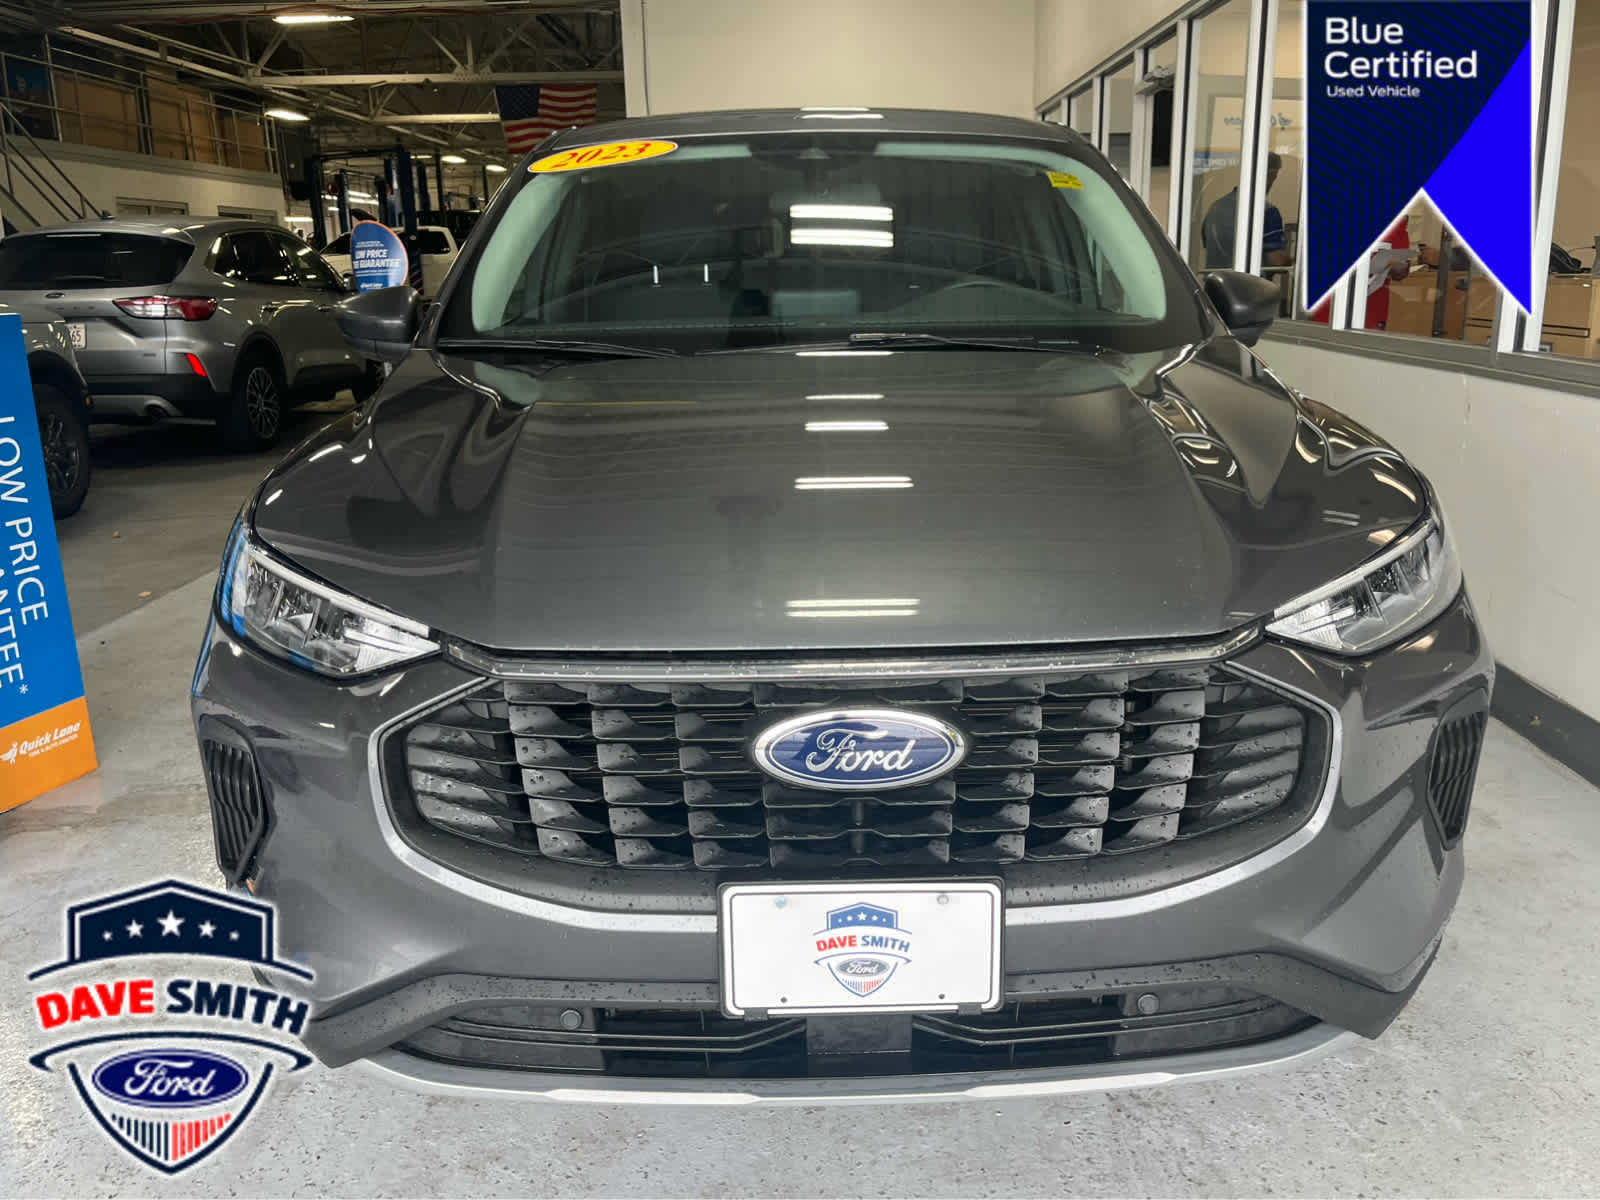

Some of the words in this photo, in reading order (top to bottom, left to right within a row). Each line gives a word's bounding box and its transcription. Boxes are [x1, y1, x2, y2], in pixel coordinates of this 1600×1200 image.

[551, 143, 651, 168] 2023
[367, 249, 388, 258] PRICE
[5, 516, 49, 625] PRICE
[19, 732, 52, 755] Quick
[53, 721, 81, 741] Lane
[805, 728, 917, 772] Ford
[816, 935, 858, 952] DAVE
[861, 935, 911, 953] SMITH
[846, 960, 880, 975] Ford
